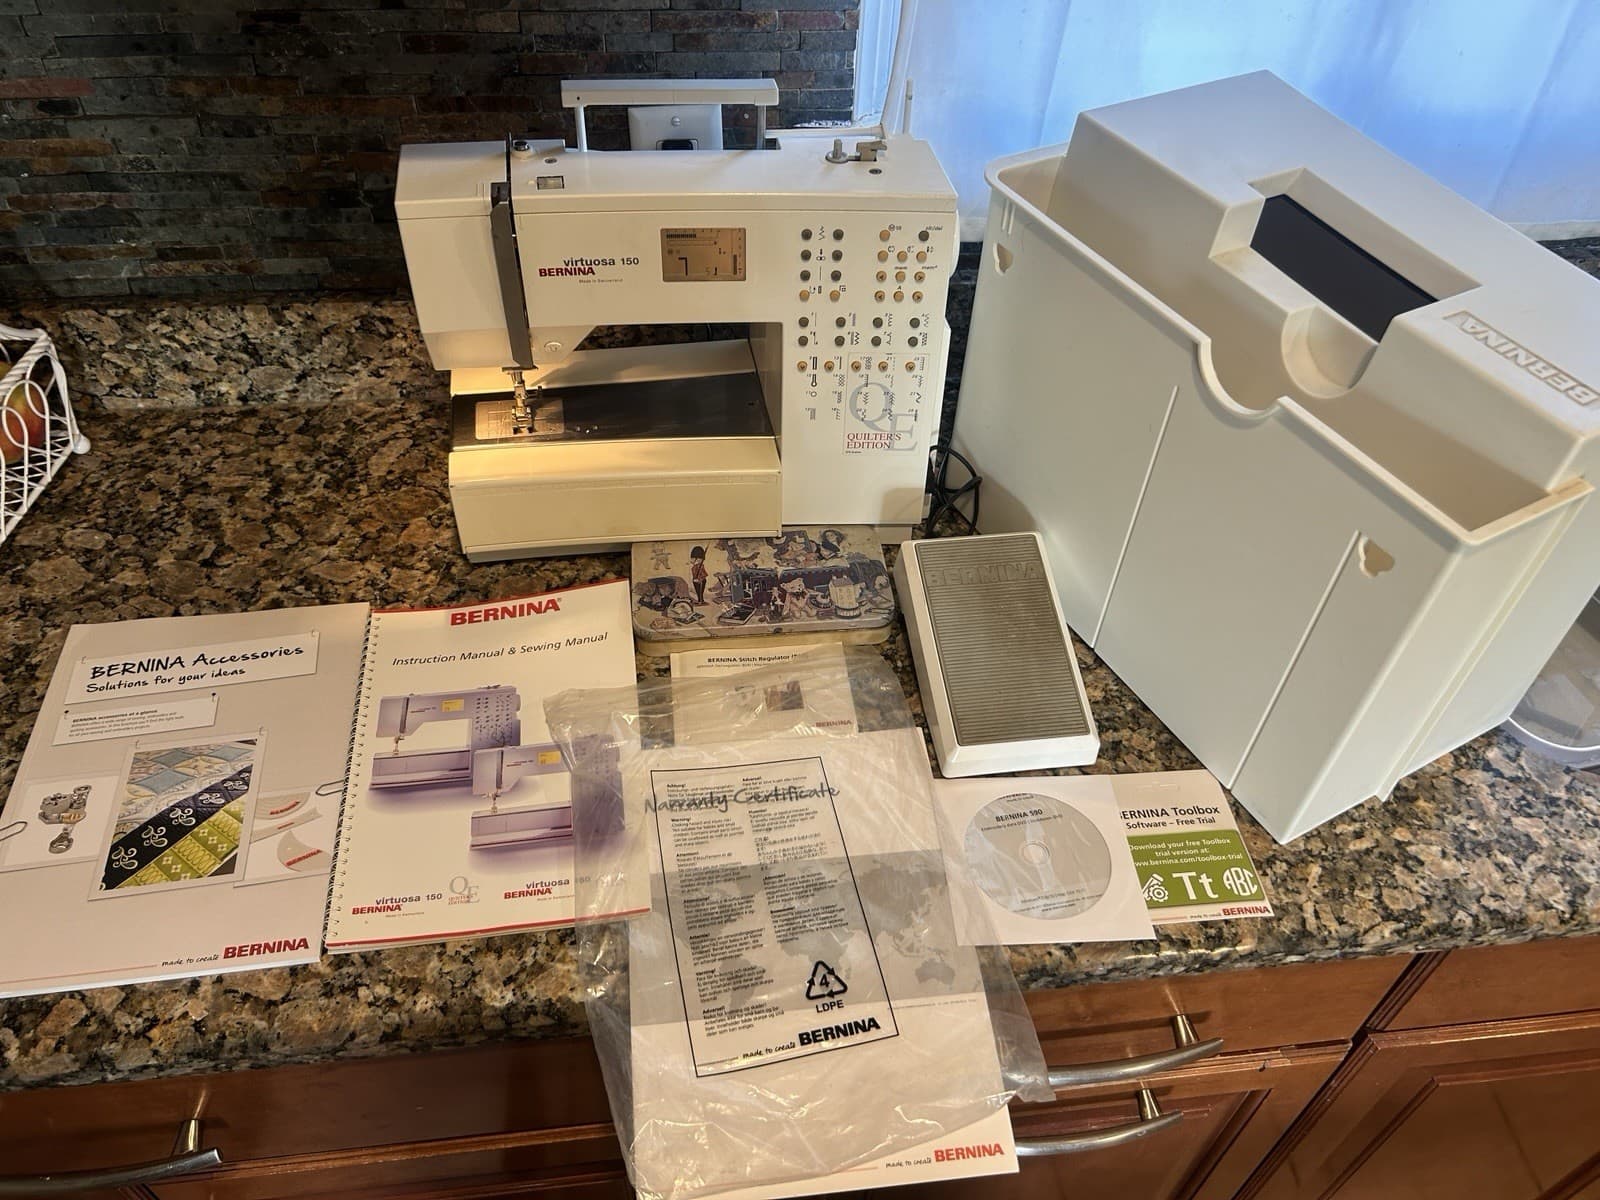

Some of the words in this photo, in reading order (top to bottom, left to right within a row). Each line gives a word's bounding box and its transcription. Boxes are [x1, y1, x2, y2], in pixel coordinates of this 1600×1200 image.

[564, 256, 616, 266] virtuosa
[620, 257, 640, 266] 150
[538, 266, 596, 277] BERNINA
[1460, 316, 1600, 407] BERNINA
[847, 432, 902, 442] QUILTER'S
[846, 441, 892, 449] EDITION
[924, 561, 1046, 586] BERNINA
[392, 654, 456, 666] Instruction
[460, 648, 504, 661] Manual
[520, 640, 561, 654] Sewing
[565, 632, 608, 648] Manual
[90, 656, 185, 680] BERNINA
[192, 646, 304, 666] Accessories
[758, 654, 790, 662] Regulator
[86, 680, 148, 693] Solutions
[155, 675, 174, 685] for
[178, 673, 206, 684] your
[212, 668, 246, 678] ideas
[995, 812, 1028, 822] BERNINA
[1120, 808, 1169, 820] ERNINA
[1172, 806, 1220, 816] Toolbox
[1126, 819, 1168, 830] Software
[1176, 818, 1195, 826] Free
[1197, 816, 1216, 824] Trial
[1168, 842, 1184, 850] your
[1173, 848, 1198, 856] version
[526, 878, 570, 890] virtuosa
[1172, 871, 1218, 900] Tt
[1223, 867, 1258, 896] ABC
[375, 894, 421, 906] virtuosa
[426, 892, 442, 900] 150
[504, 887, 552, 900] BERNINA
[352, 904, 402, 915] BERNINA
[1222, 906, 1271, 916] BERNINA
[162, 958, 184, 966] made
[196, 954, 219, 962] create
[223, 937, 310, 959] BERNINA
[820, 974, 830, 988] 4
[816, 1000, 844, 1013] LDPE
[742, 1050, 764, 1059] made
[774, 1042, 796, 1052] create
[798, 1016, 880, 1046] BERNINA
[934, 1143, 1004, 1162] BERNINA
